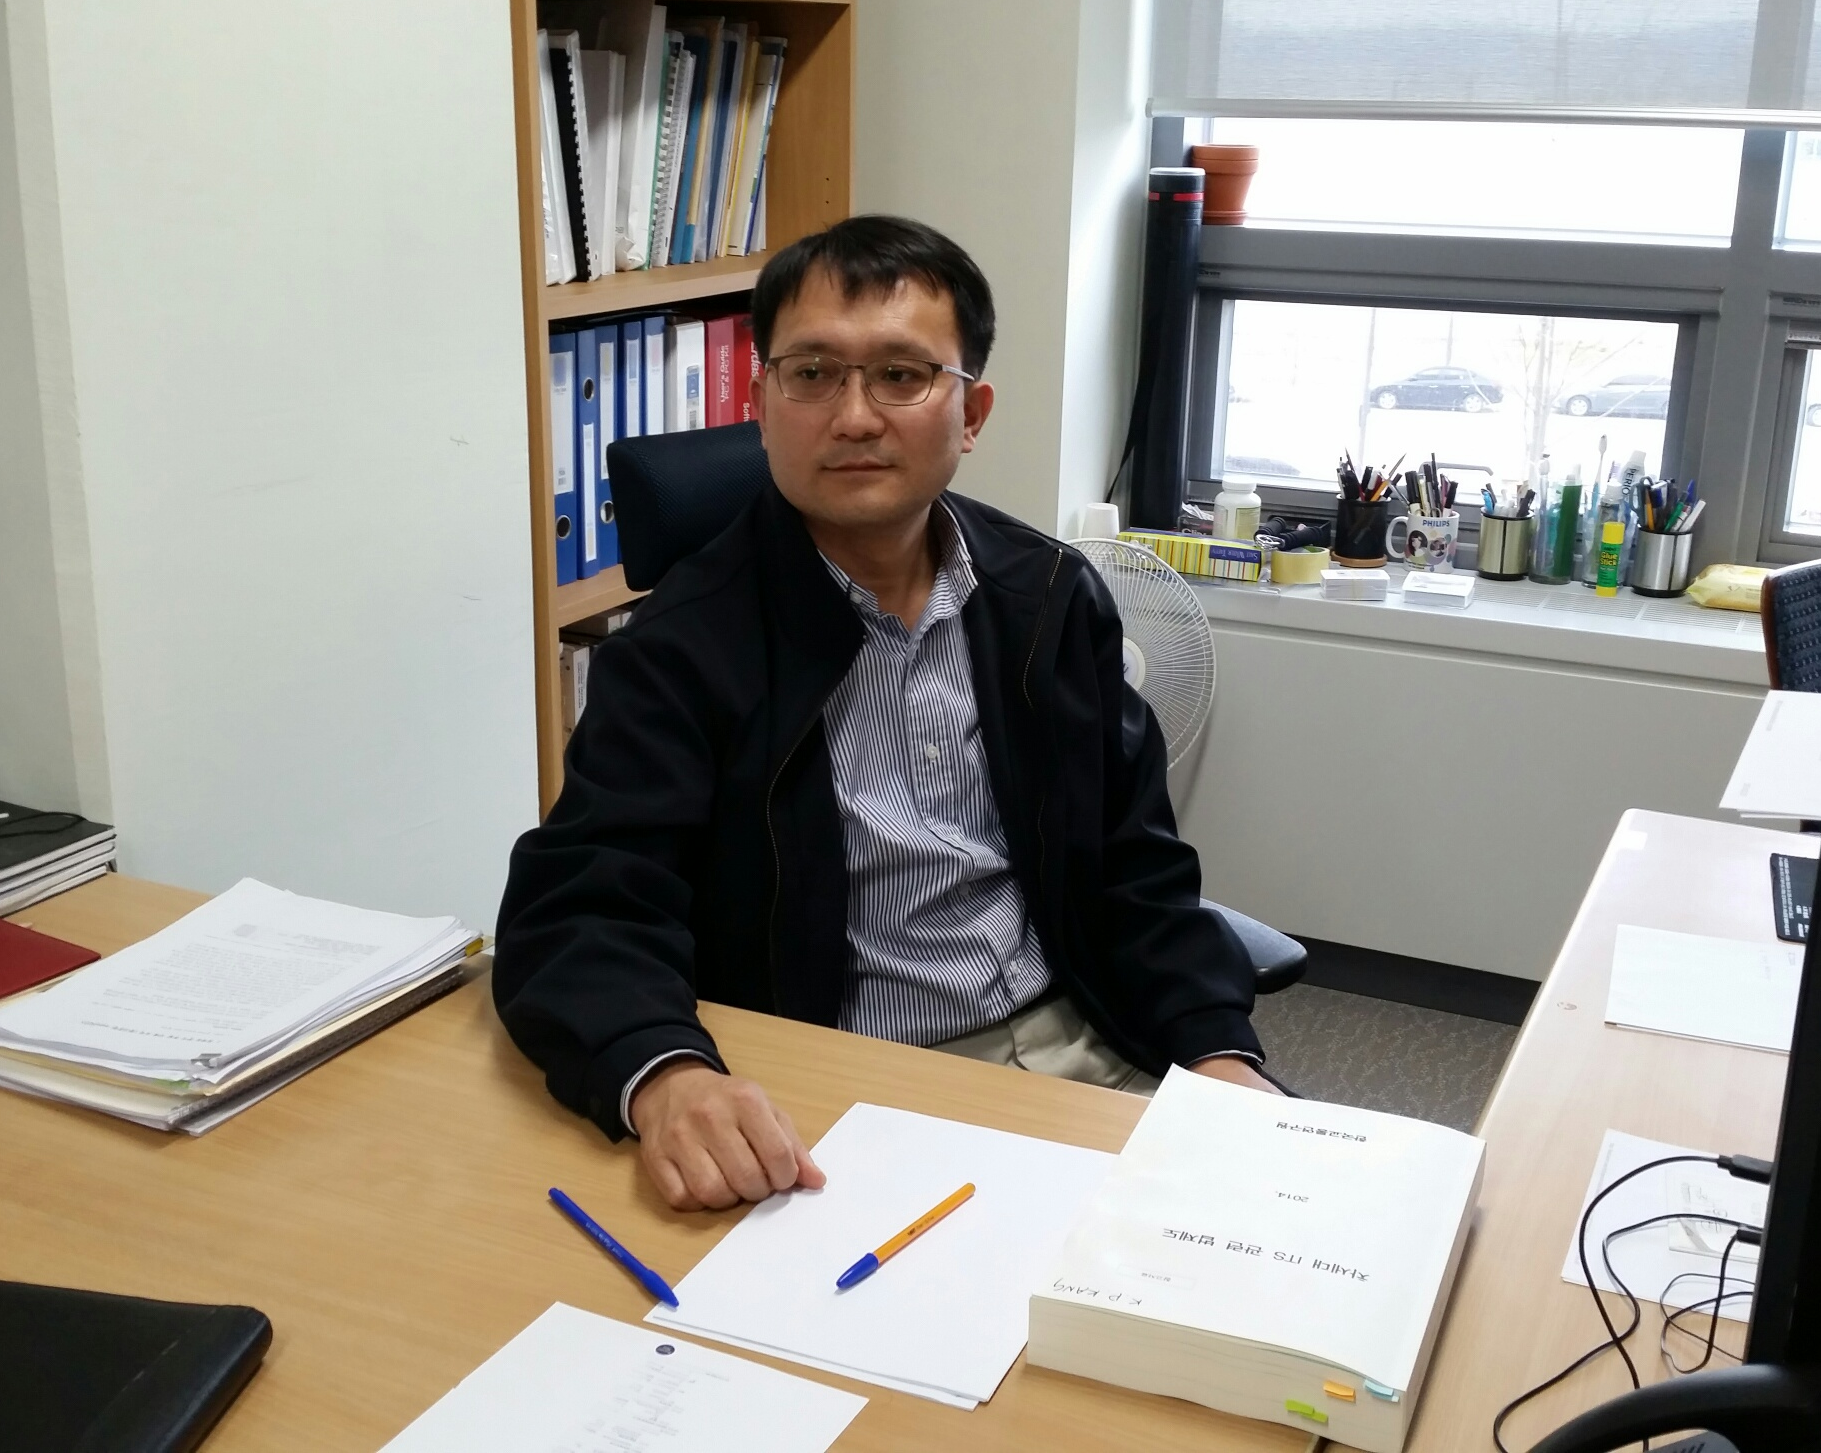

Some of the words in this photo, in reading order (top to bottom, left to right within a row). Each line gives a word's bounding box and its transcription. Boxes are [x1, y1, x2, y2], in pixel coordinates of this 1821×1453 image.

[751, 341, 762, 377] rdas
[1622, 468, 1636, 496] PERIO
[1422, 519, 1450, 527] PHILIPS
[1599, 557, 1617, 566] Stick
[1601, 551, 1618, 560] Glue
[1276, 1121, 1367, 1142] 한국교통연구원
[1162, 1228, 1215, 1246] 법제도
[1225, 1240, 1263, 1257] 관련
[1273, 1251, 1302, 1264] ITS
[1312, 1258, 1370, 1282] 차세대
[1053, 1277, 1100, 1298] KANG
